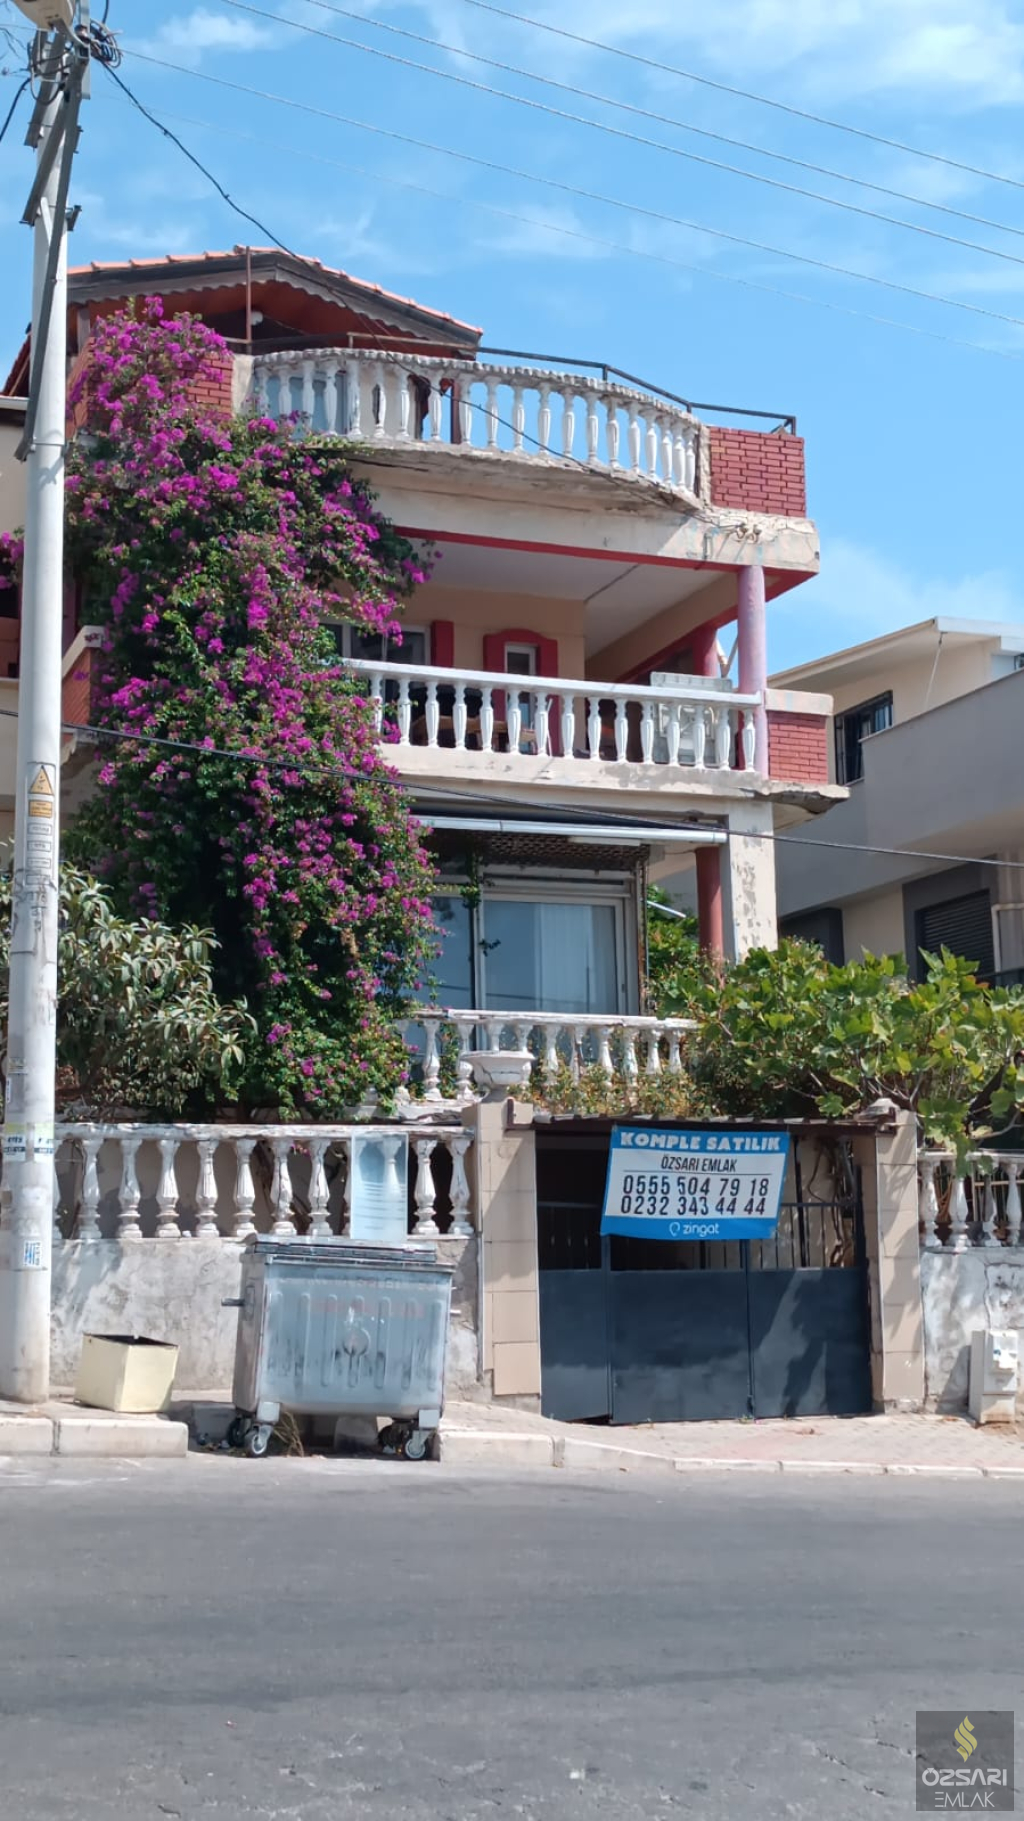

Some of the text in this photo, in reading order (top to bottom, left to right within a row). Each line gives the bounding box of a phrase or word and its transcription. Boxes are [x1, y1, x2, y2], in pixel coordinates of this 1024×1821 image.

[620, 1132, 780, 1150] KOMPLE SATILIK
[661, 1154, 737, 1172] ÖZSARI EMLAK
[623, 1175, 769, 1196] 0555 504 79 18
[620, 1195, 766, 1215] 0232 343 44 44
[682, 1222, 719, 1236] zingat
